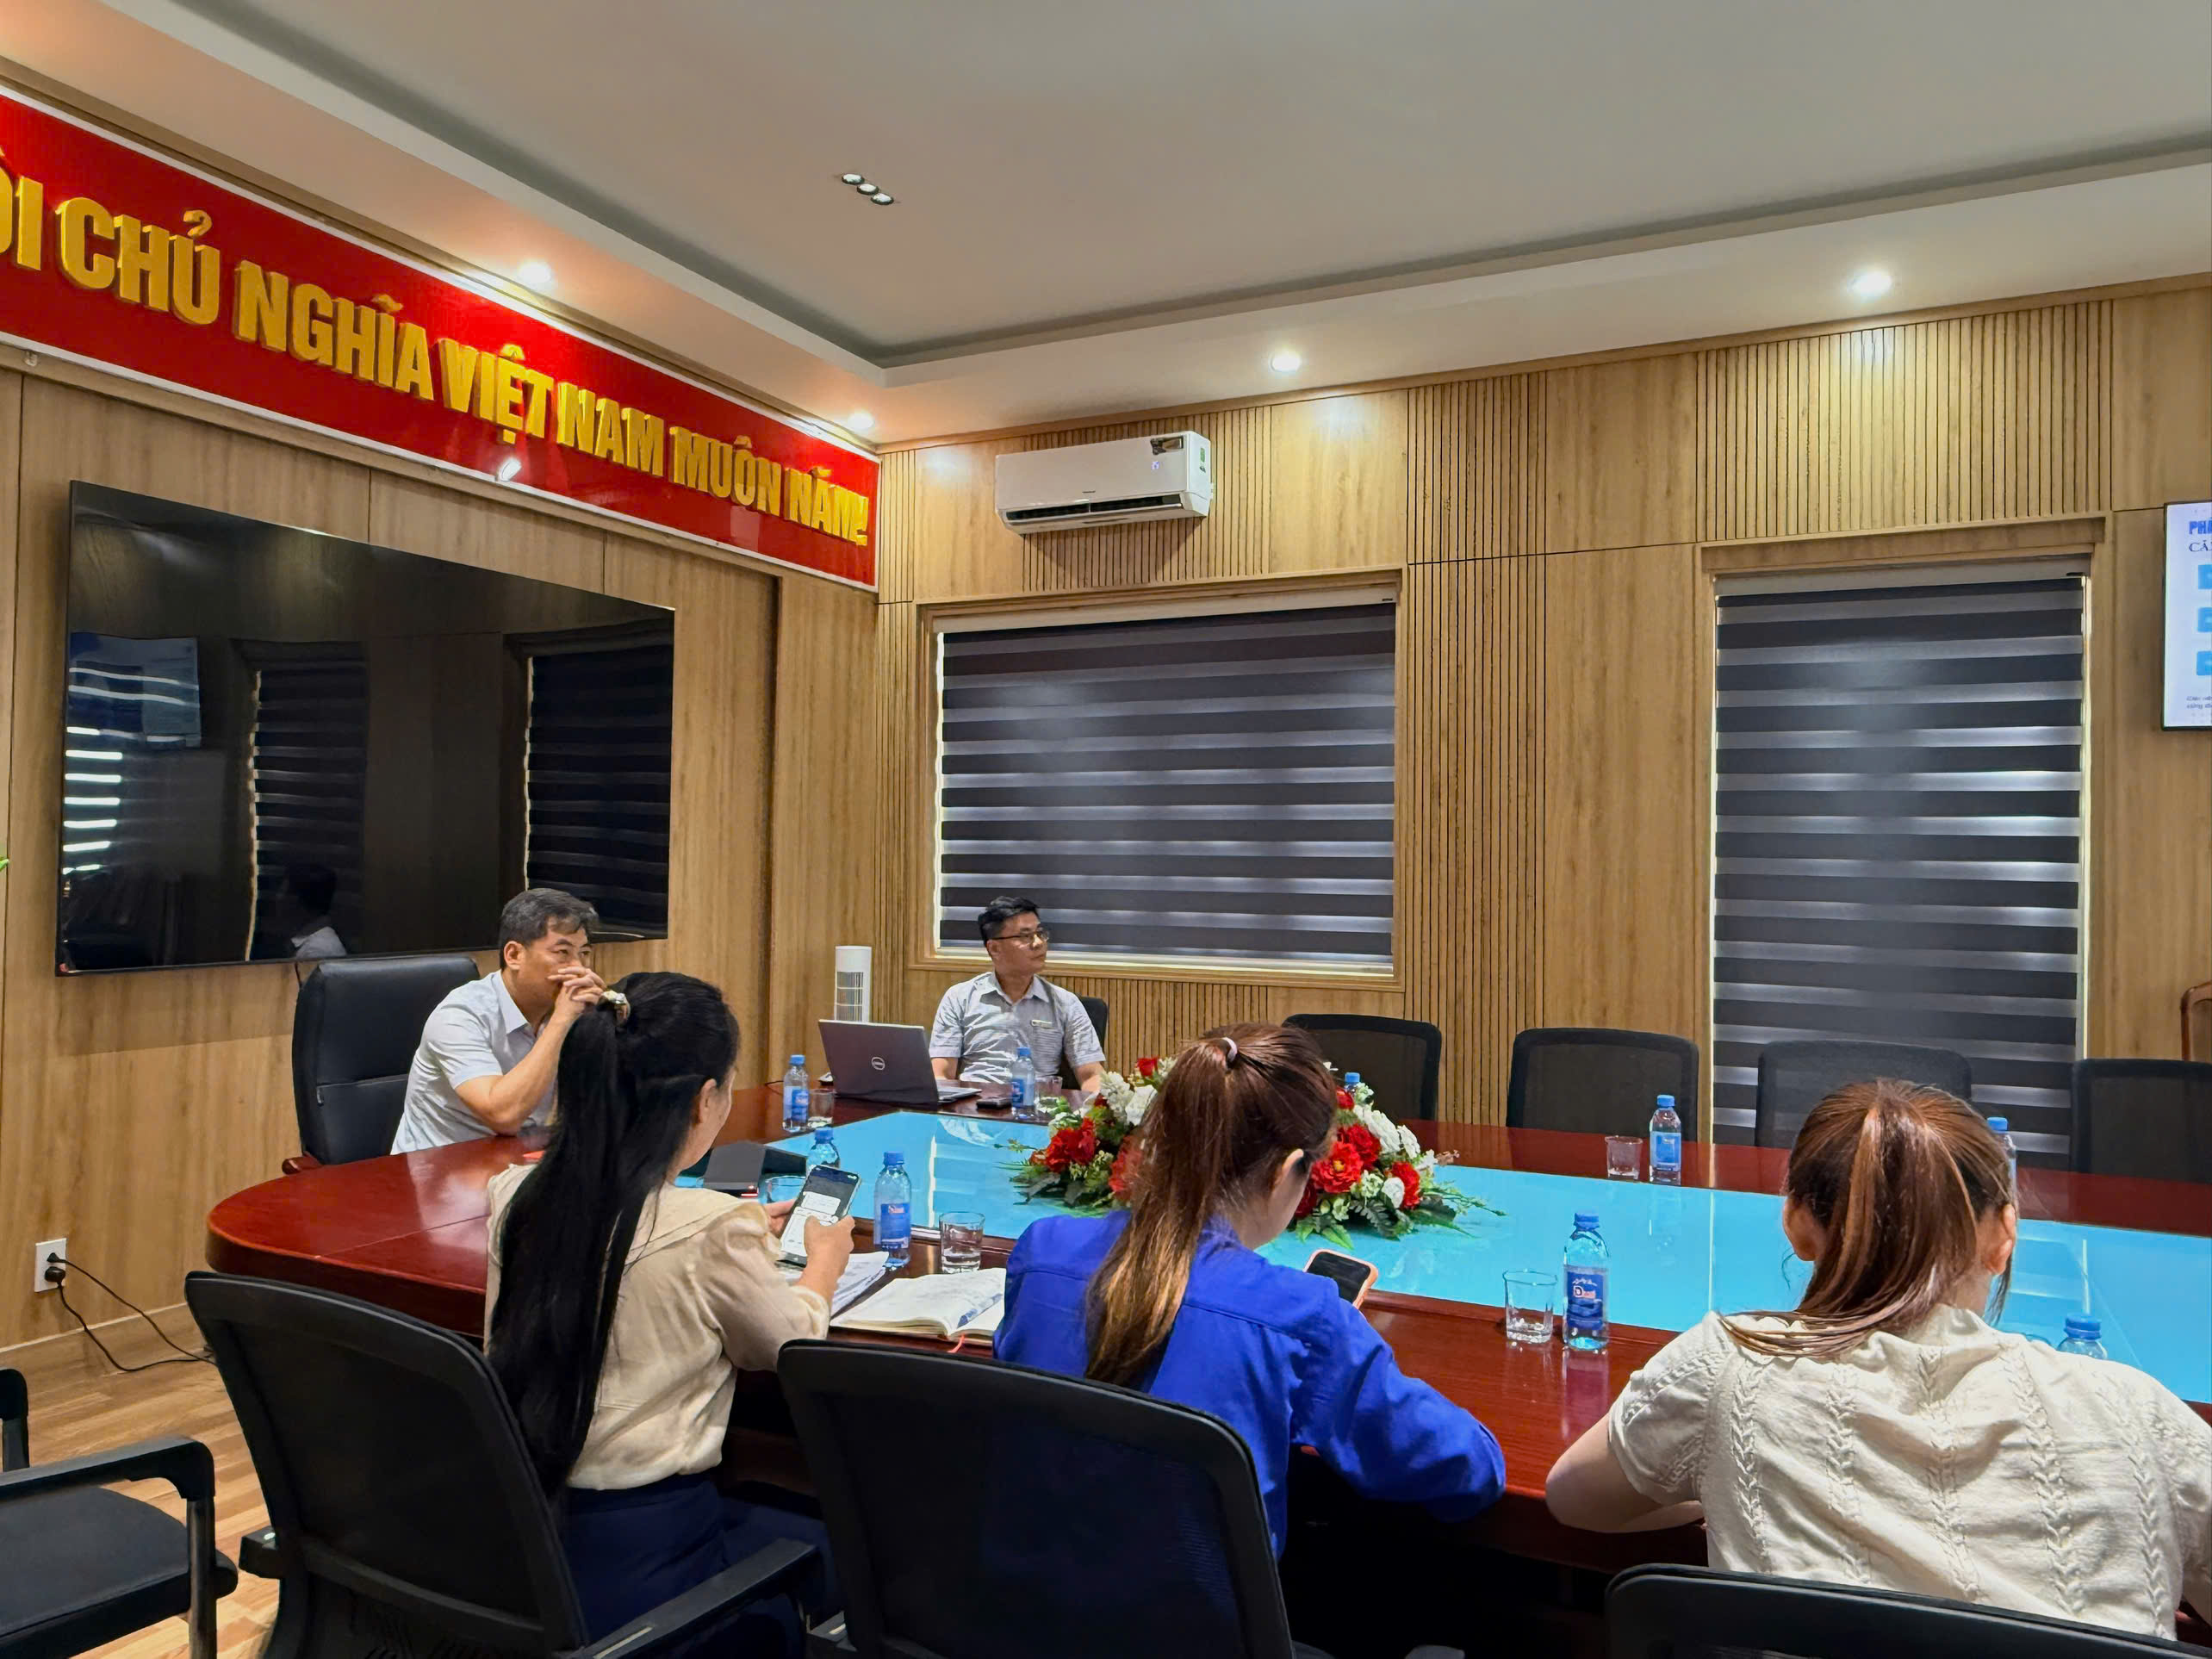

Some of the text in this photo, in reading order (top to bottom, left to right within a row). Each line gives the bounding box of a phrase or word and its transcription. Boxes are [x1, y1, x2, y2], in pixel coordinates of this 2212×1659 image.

[55, 196, 221, 326] CHỦ
[234, 260, 434, 401] NGHĨA
[438, 338, 555, 444] VIỆT
[556, 382, 665, 477] NAM
[668, 426, 781, 517] MUÔN
